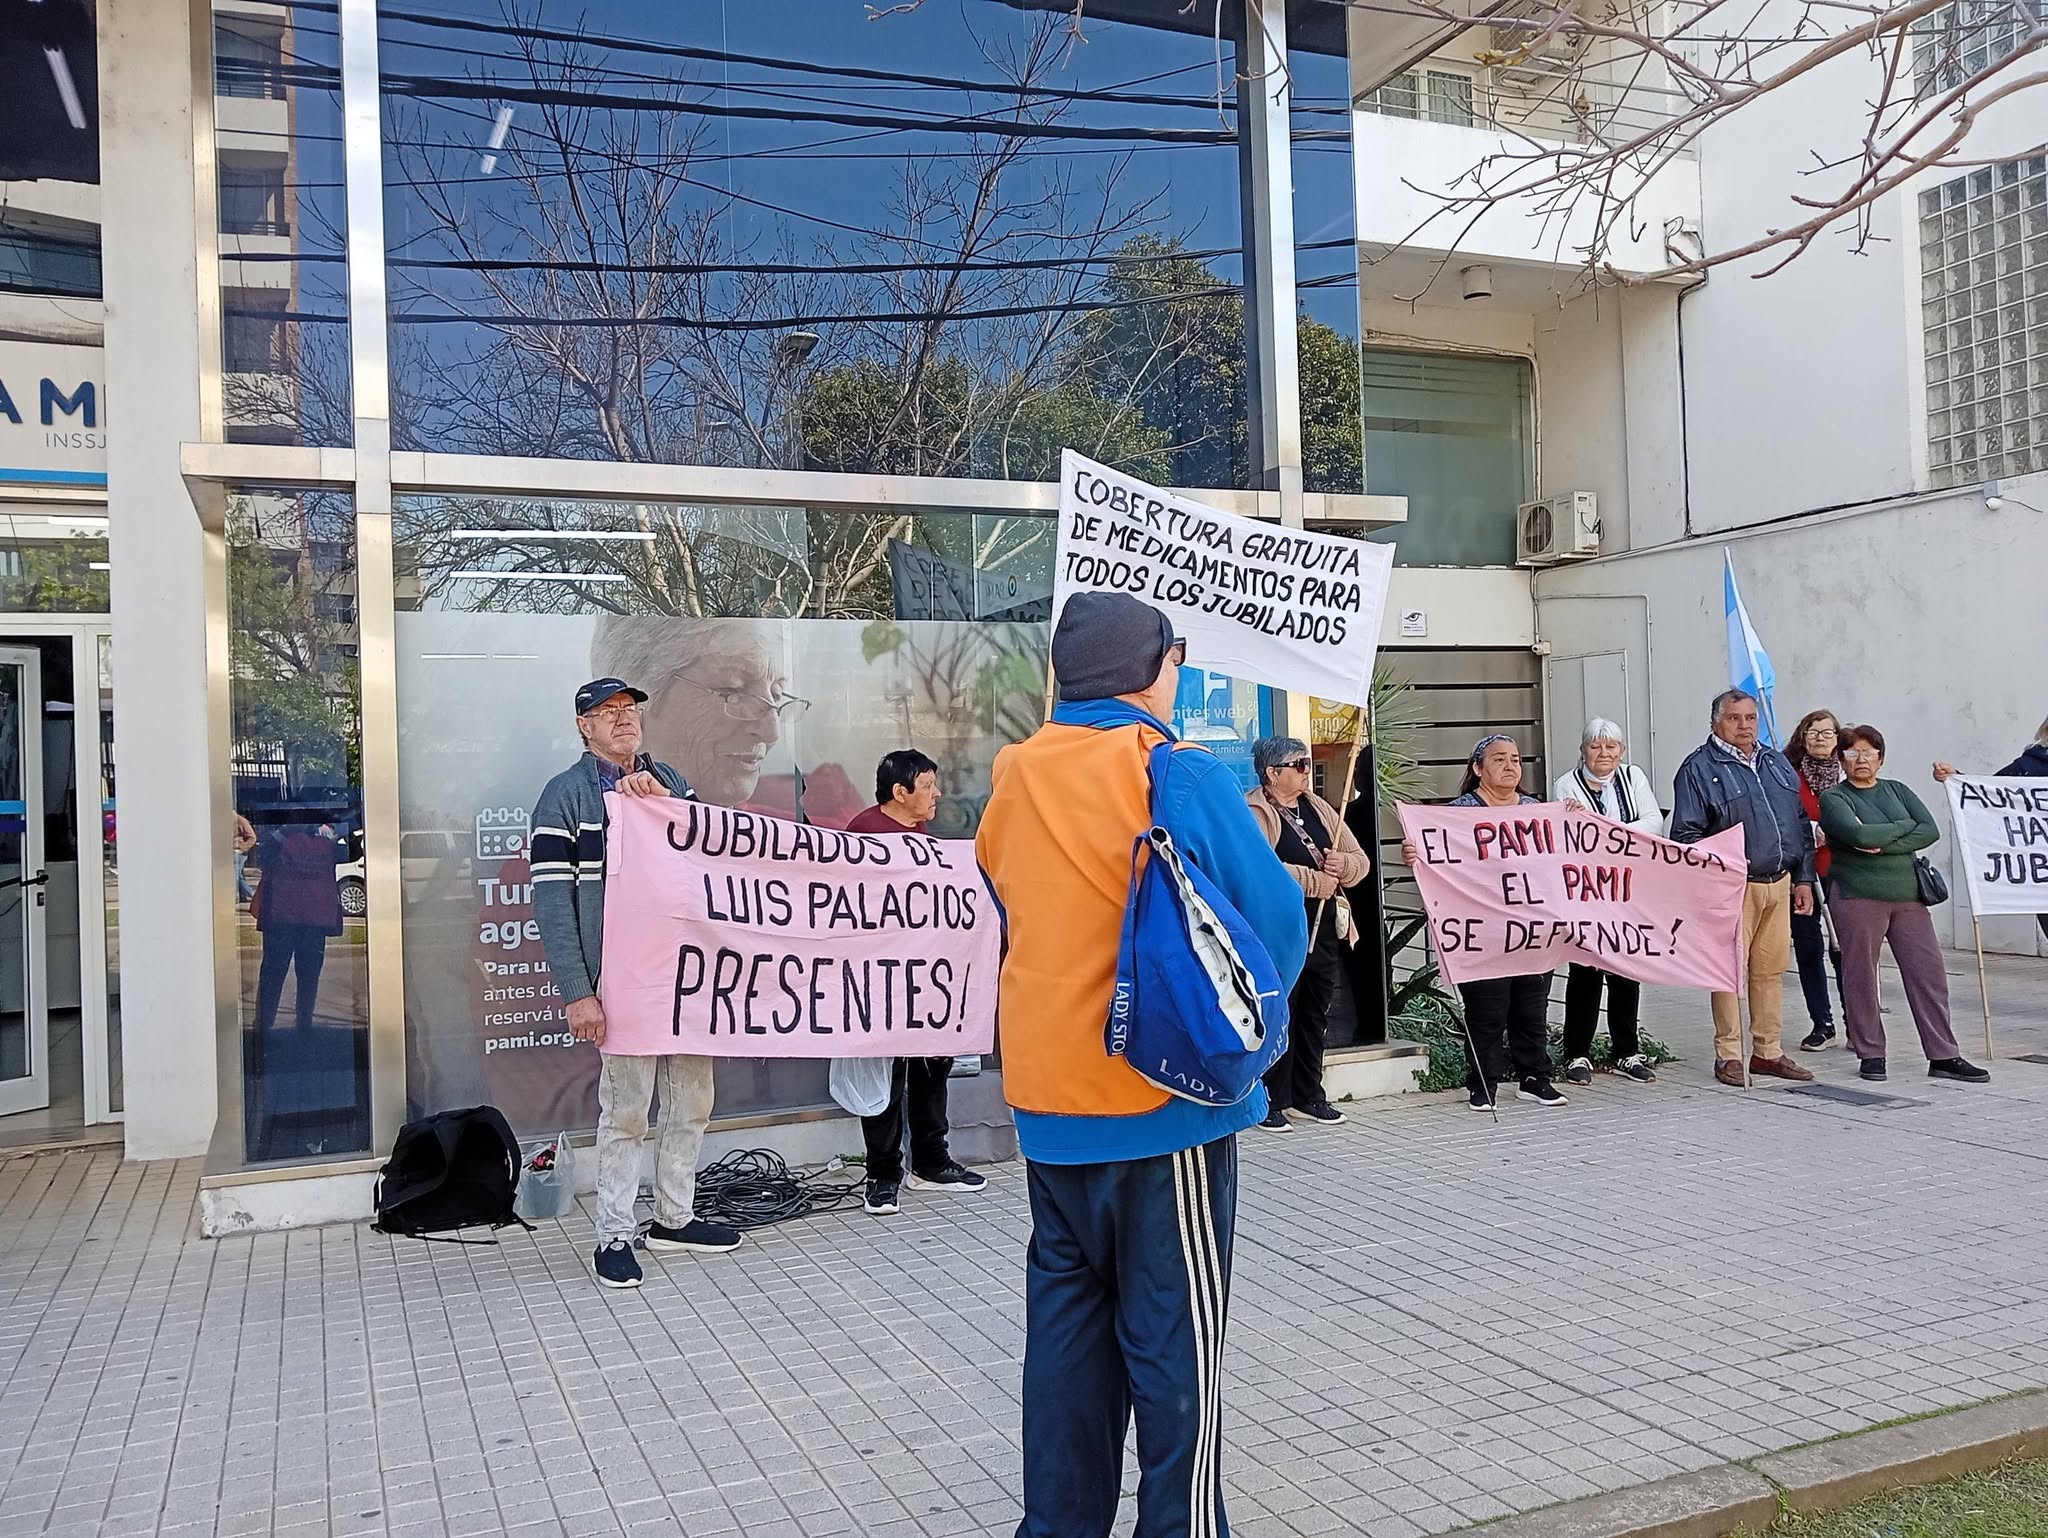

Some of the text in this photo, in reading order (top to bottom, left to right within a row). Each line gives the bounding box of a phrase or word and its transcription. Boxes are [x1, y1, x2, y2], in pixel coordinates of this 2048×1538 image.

[0, 377, 106, 428] AM
[1074, 471, 1361, 577] COBERTURA GRATUITA
[1070, 511, 1361, 613] DE MEDICAMENTOS PARA
[1066, 551, 1347, 646] TODOS LOS JUBILADOS
[1213, 704, 1246, 719] web
[667, 804, 953, 869] JUBILADOS DE
[1421, 828, 1462, 864] EL
[1473, 818, 1556, 861] PAMI
[1564, 820, 1600, 854] NO
[1607, 827, 1642, 858] SE
[2003, 815, 2048, 847] HA
[703, 873, 978, 930] LUIS PALACIOS
[1502, 863, 1633, 905] EL PAMI
[480, 919, 541, 949] age
[1433, 917, 1484, 953] SE
[483, 962, 530, 976] Para
[672, 944, 971, 1036] PRESENTES!
[484, 981, 561, 1001] antes de
[484, 1005, 553, 1026] reservá
[1111, 982, 1130, 1055] LADY STO
[485, 1031, 587, 1055] pami.org.
[1159, 1058, 1219, 1099] LADY
